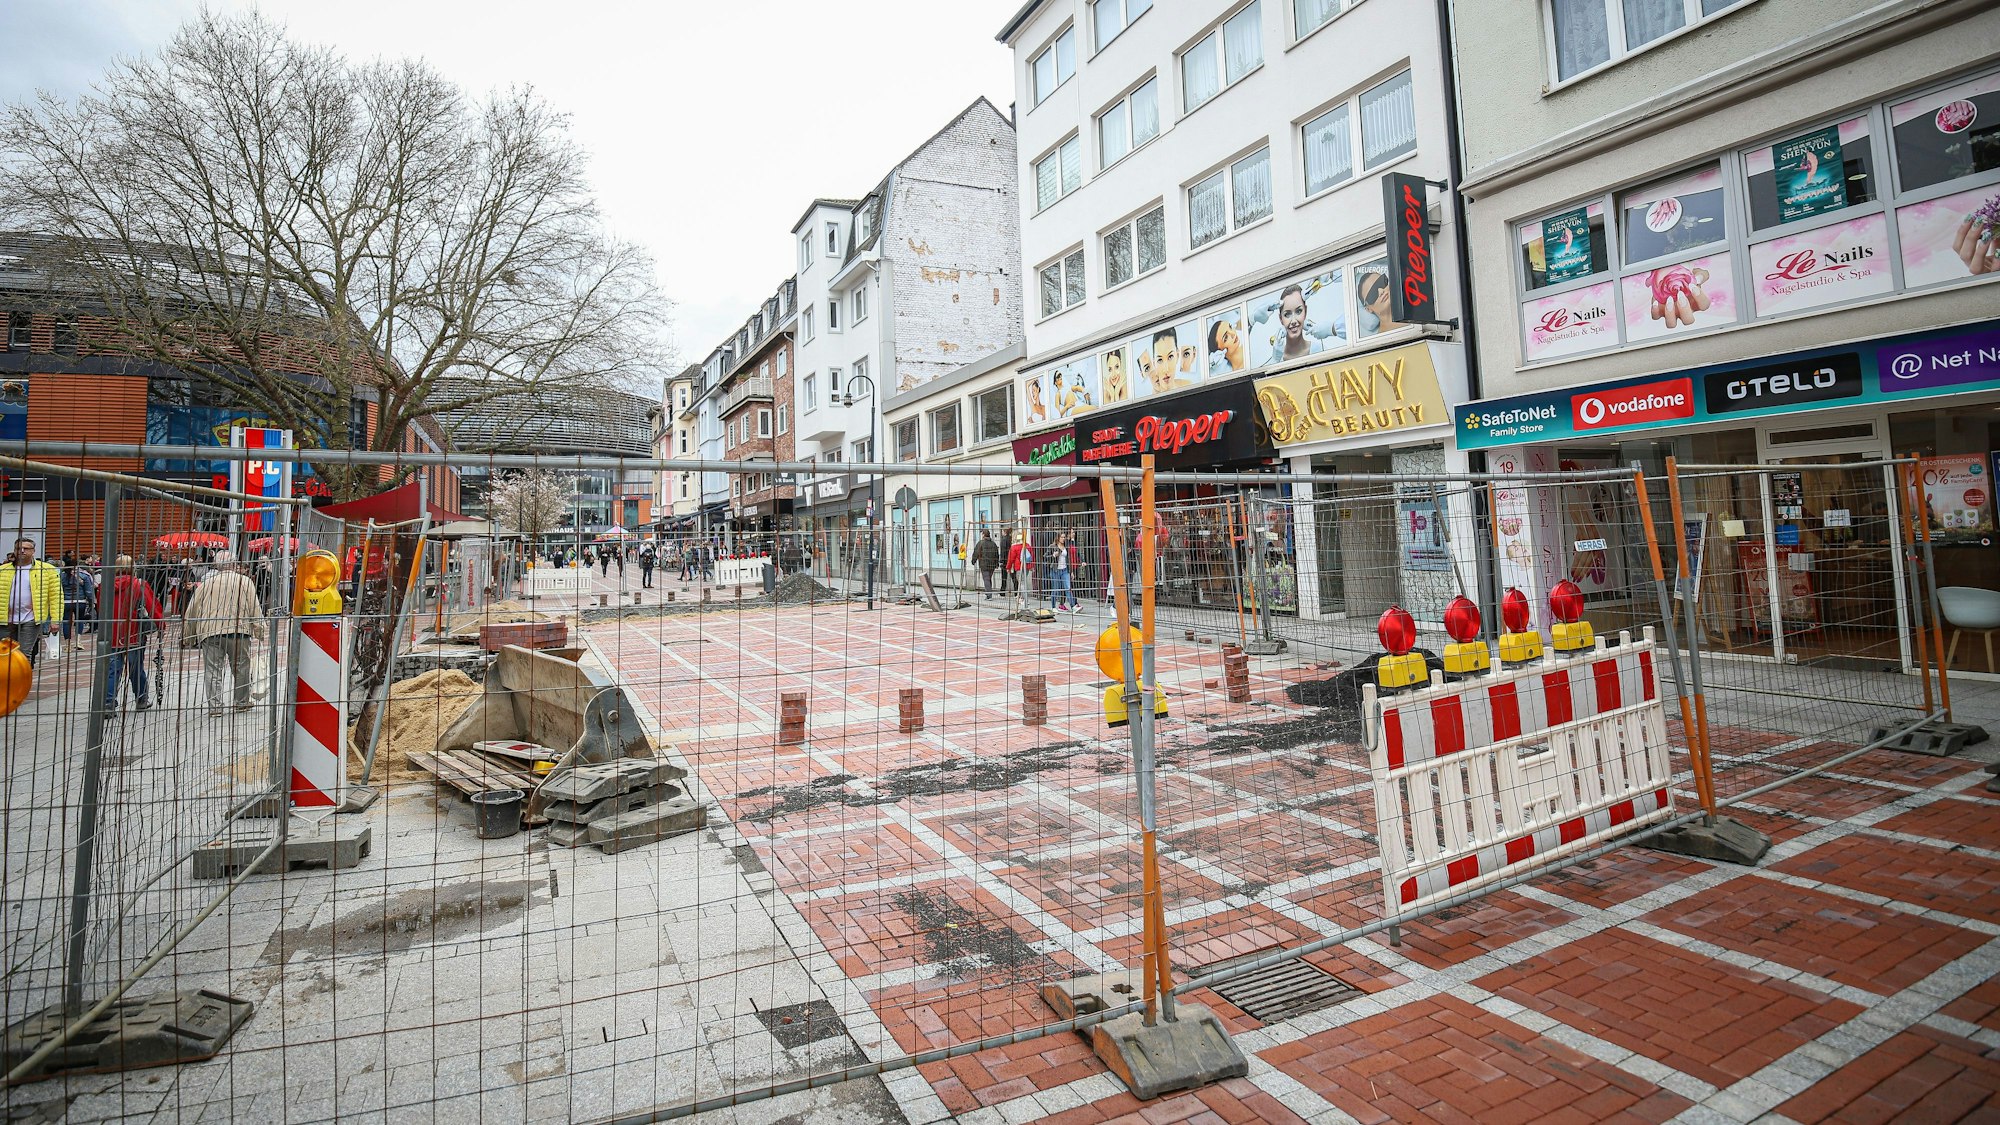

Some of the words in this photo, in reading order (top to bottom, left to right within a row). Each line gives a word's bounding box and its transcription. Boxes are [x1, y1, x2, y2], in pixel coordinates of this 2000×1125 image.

[1780, 148, 1808, 161] SHEN
[1810, 140, 1831, 152] YUN
[1547, 222, 1566, 234] SHEN
[1567, 218, 1582, 229] YUN
[1403, 184, 1429, 307] Pieper
[1765, 249, 1817, 281] Le
[1824, 245, 1874, 266] Nails
[1771, 276, 1834, 296] Nagelstudio
[1837, 272, 1847, 282] &
[1849, 268, 1872, 280] Spa
[1533, 307, 1569, 333] Le
[1573, 306, 1606, 322] Nails
[1537, 330, 1580, 345] Nagelstudio
[1590, 325, 1605, 335] Spa
[1930, 350, 1972, 370] Net
[1607, 393, 1685, 415] vodafone
[1330, 402, 1424, 435] BEAUTY
[1481, 404, 1557, 427] SafeToNet
[1134, 409, 1234, 455] Pieper
[1490, 426, 1518, 438] Family
[1520, 423, 1544, 434] Store
[1500, 461, 1514, 474] 19
[1576, 540, 1603, 550] HERAS
